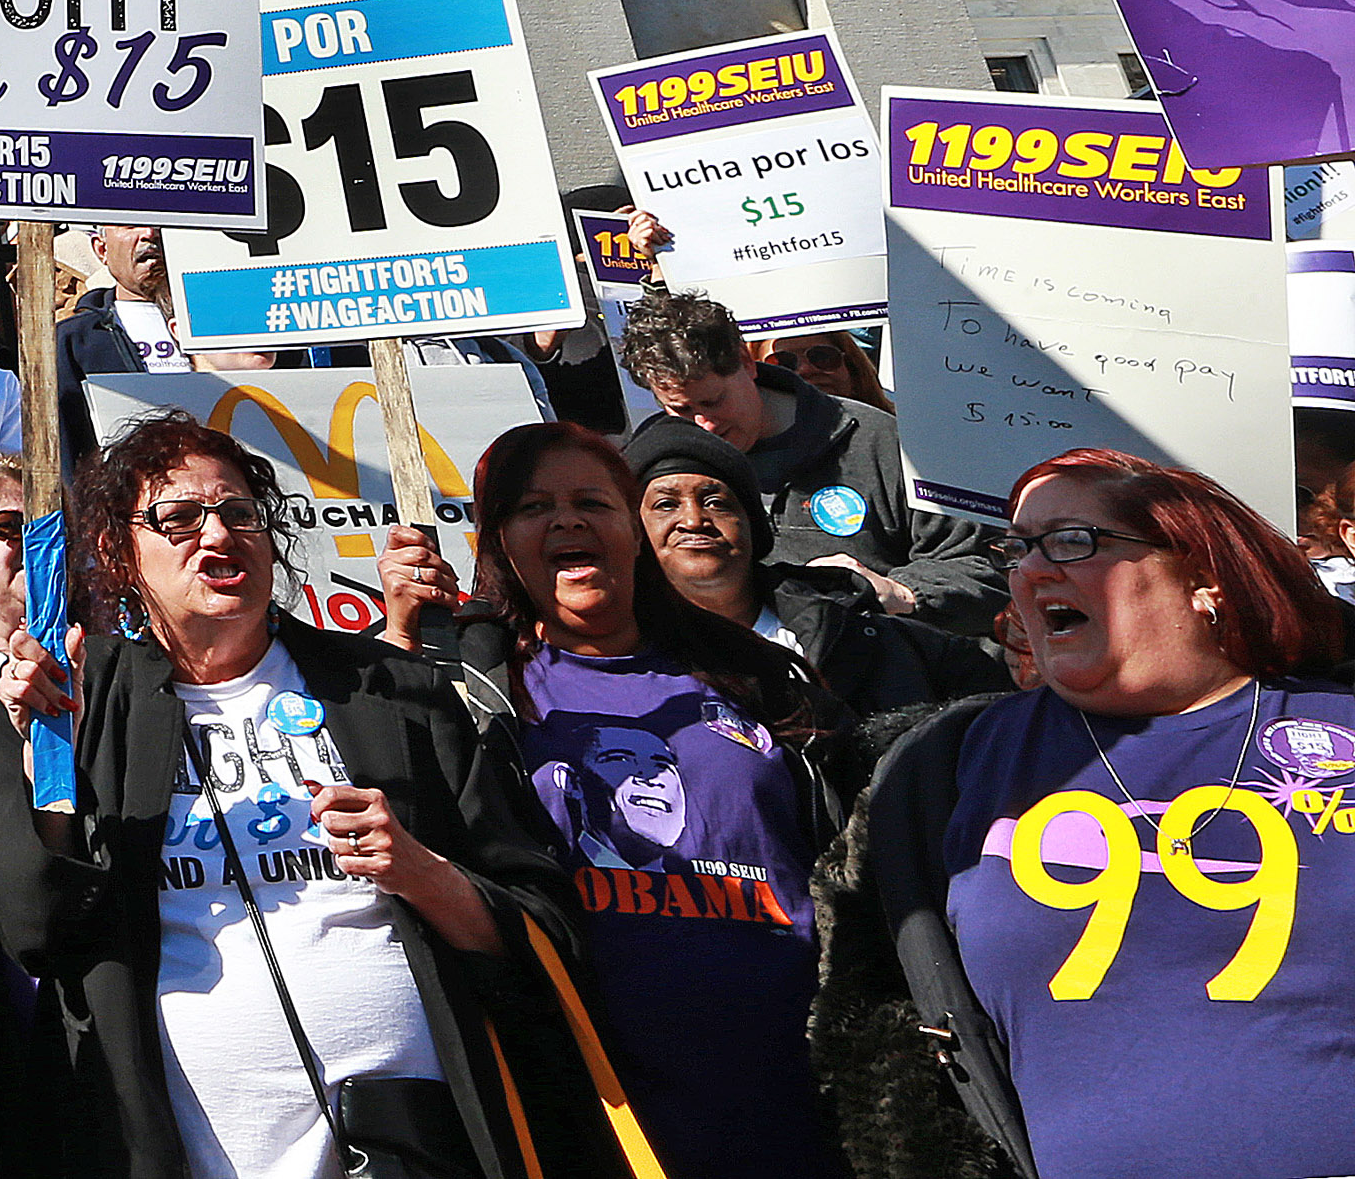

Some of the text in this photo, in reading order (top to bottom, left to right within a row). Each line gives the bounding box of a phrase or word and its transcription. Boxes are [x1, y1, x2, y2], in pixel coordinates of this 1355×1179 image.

[271, 9, 374, 63] POR
[38, 27, 228, 111] $15
[614, 50, 826, 116] 1199SEIU
[625, 81, 836, 129] United Healthcare Workers East
[102, 156, 249, 183] 1199SEIU
[104, 179, 248, 193] United Healthcare Workers East
[644, 138, 870, 193] Lucha por los
[740, 192, 805, 227] $15
[908, 166, 1246, 211] United Healthcare Workers East
[1293, 191, 1348, 226] #fightfor15
[602, 257, 638, 270] United
[733, 231, 844, 263] #fightfor15
[271, 254, 469, 298] #FIGHTFOR15
[266, 288, 488, 332] #WAGEACTION
[1067, 284, 1173, 324] coming
[1002, 324, 1075, 357] have
[1093, 352, 1158, 375] good
[291, 502, 401, 529] UCHA
[159, 856, 205, 891] ND
[692, 859, 767, 882] 1199 SEIU
[575, 867, 793, 925] OBAMA
